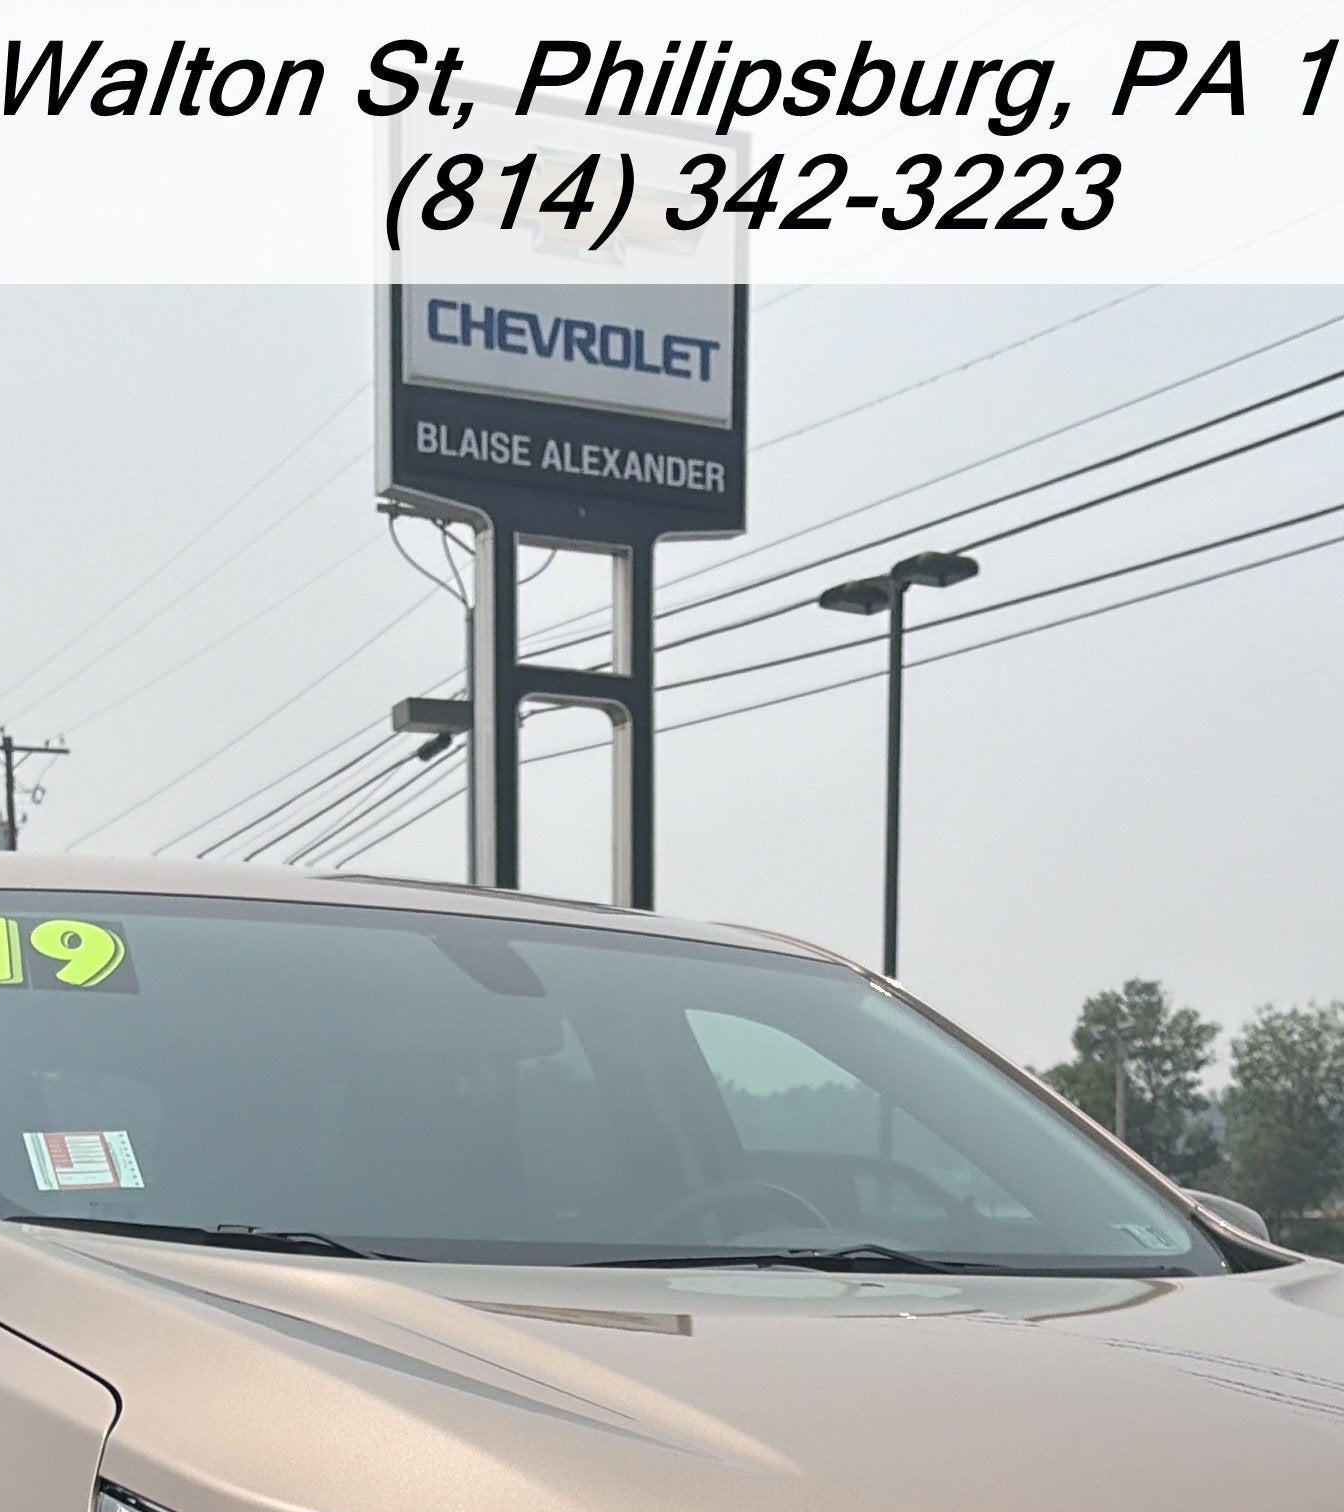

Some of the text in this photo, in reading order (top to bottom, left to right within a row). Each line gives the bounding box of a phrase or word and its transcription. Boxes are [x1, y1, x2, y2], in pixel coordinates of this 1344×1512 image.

[427, 299, 720, 382] CHEVROLET
[417, 421, 725, 493] BLAISE ALEXANDER
